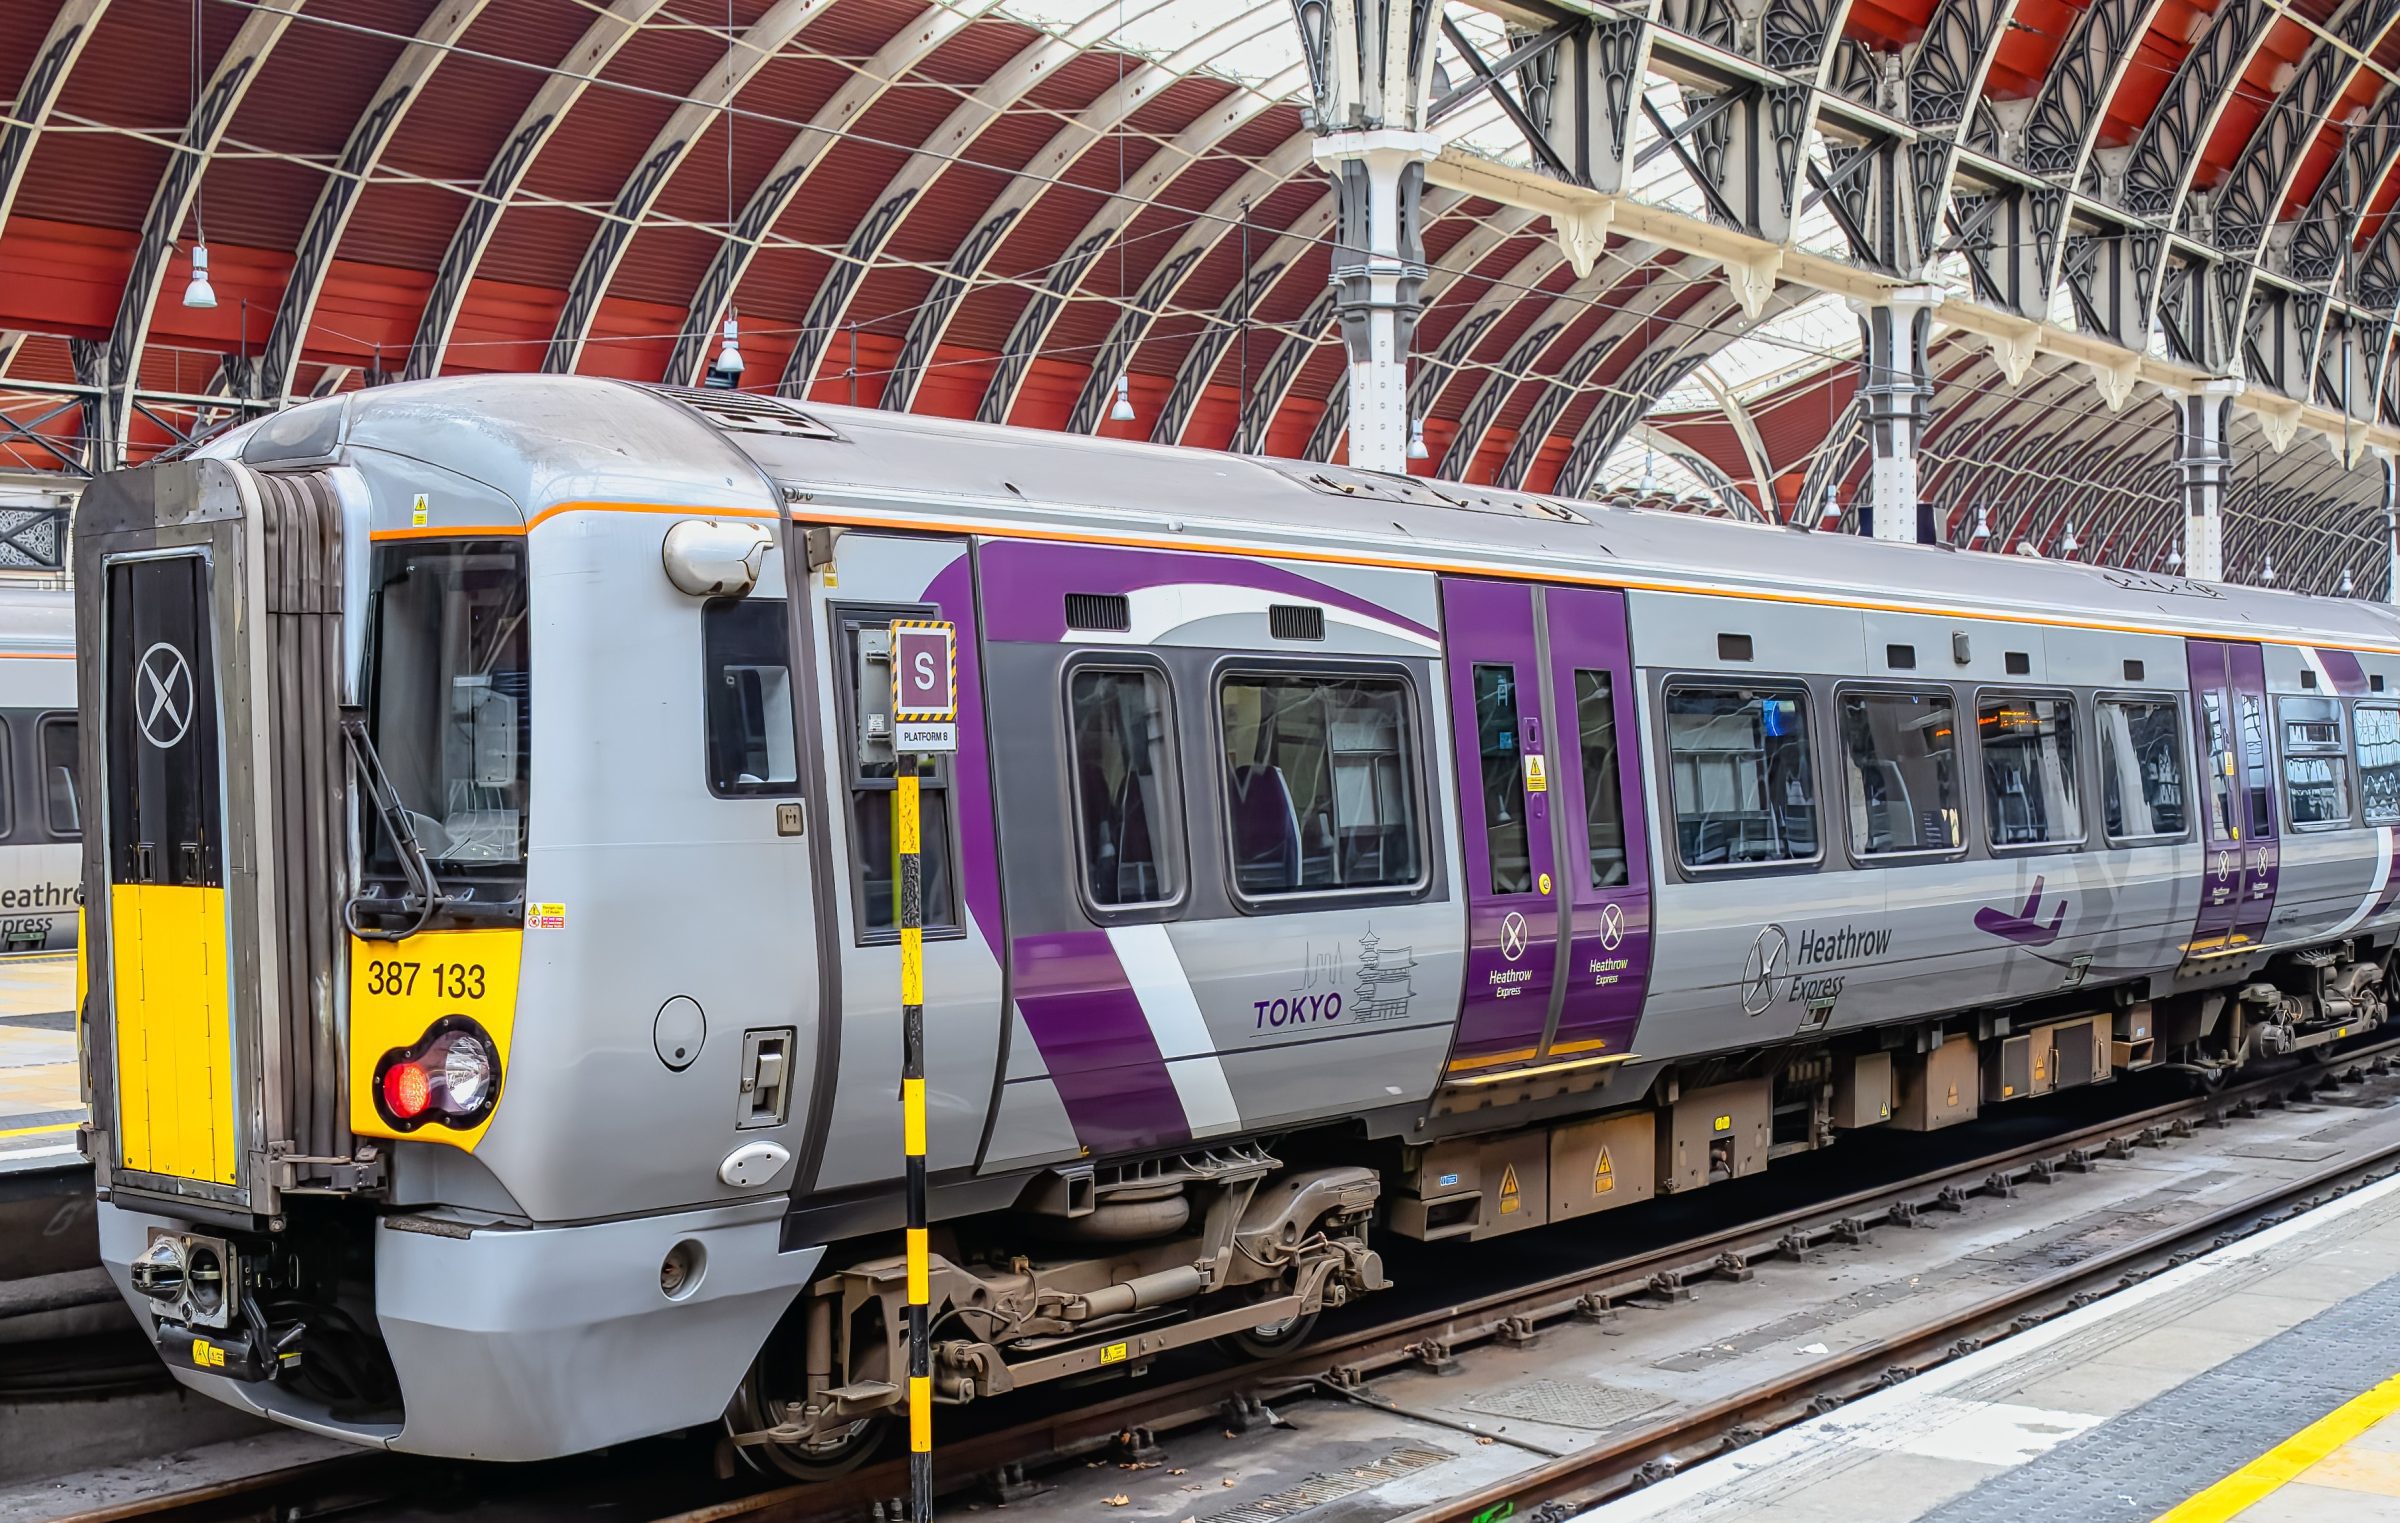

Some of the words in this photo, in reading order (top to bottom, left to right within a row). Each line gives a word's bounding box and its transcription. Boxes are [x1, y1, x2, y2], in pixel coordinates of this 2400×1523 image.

[913, 651, 936, 691] S
[904, 731, 942, 742] PLATFORM
[0, 917, 53, 938] press
[1797, 923, 1893, 966] Heathrow
[1588, 957, 1629, 973] Heathrow
[367, 960, 421, 996] 387
[432, 963, 486, 999] 133
[1488, 968, 1533, 985] Heathrow
[1595, 974, 1619, 987] Express
[1496, 986, 1522, 999] Express
[1787, 975, 1846, 1007] Express
[1253, 992, 1342, 1029] TOKYO
